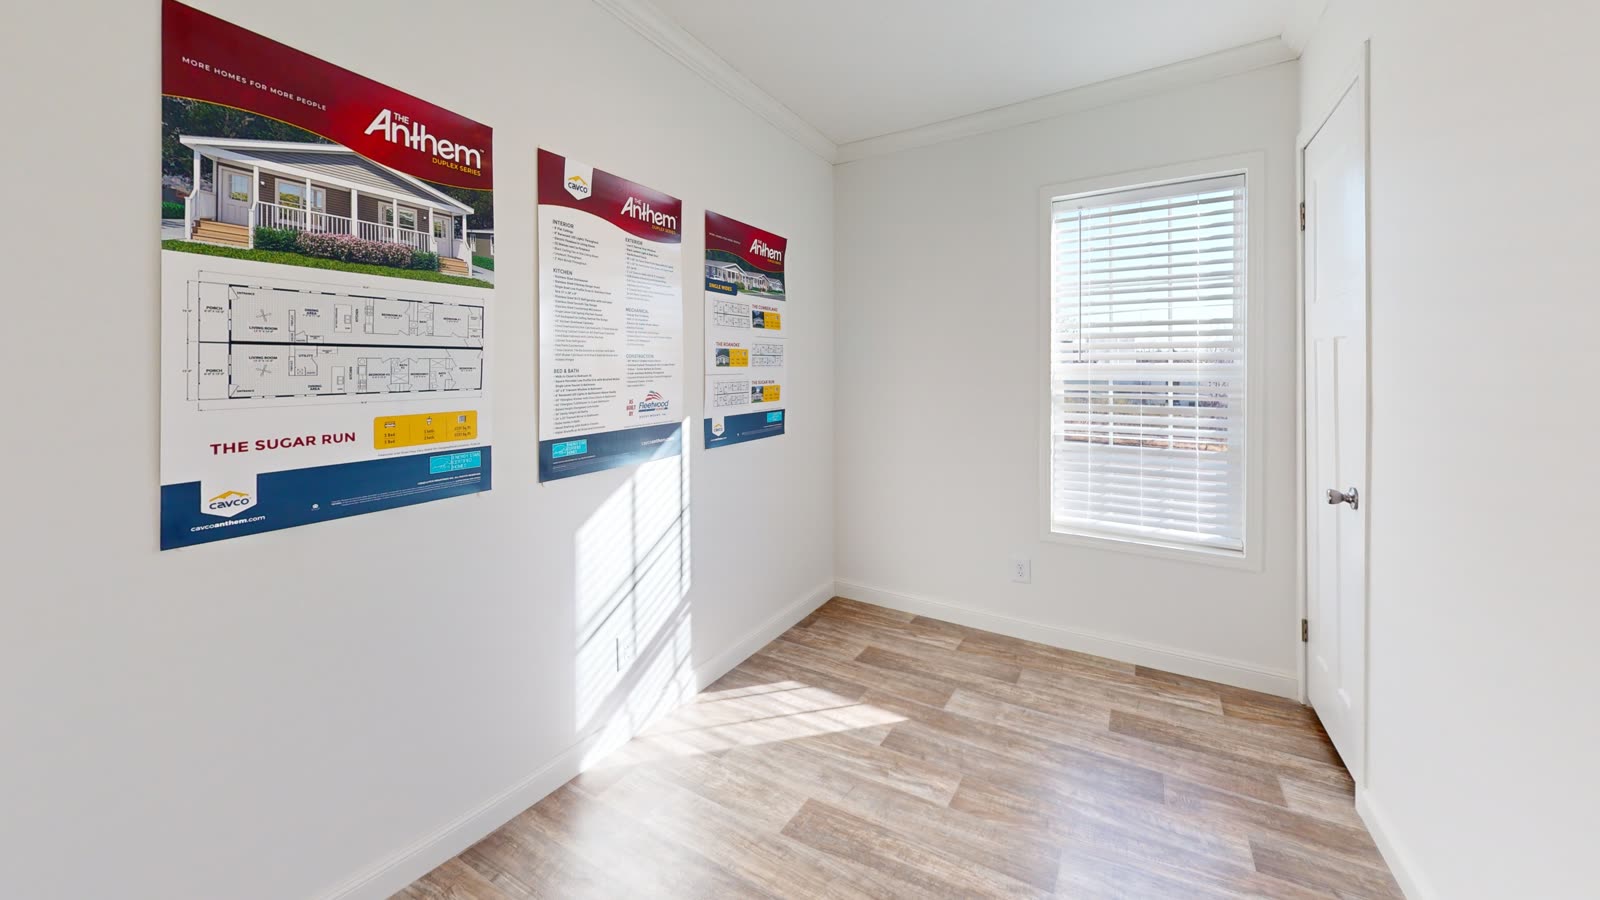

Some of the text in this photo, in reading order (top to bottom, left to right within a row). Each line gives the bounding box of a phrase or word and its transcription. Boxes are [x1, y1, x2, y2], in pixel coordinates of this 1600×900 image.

[182, 56, 326, 111] MORE HOMES FOR MORE PEOPLE
[393, 112, 409, 125] THE
[364, 108, 481, 169] Anthem
[432, 156, 481, 176] DUPLEX SERIES
[568, 182, 588, 194] cavco
[620, 197, 676, 230] Anthem
[552, 219, 574, 229] INTERIOR
[749, 239, 782, 261] Anthem
[639, 400, 669, 409] Fleetwood
[209, 432, 356, 455] THE SUGAR RUN
[209, 497, 250, 510] cavco
[190, 514, 266, 532] cavcoanthem.com
